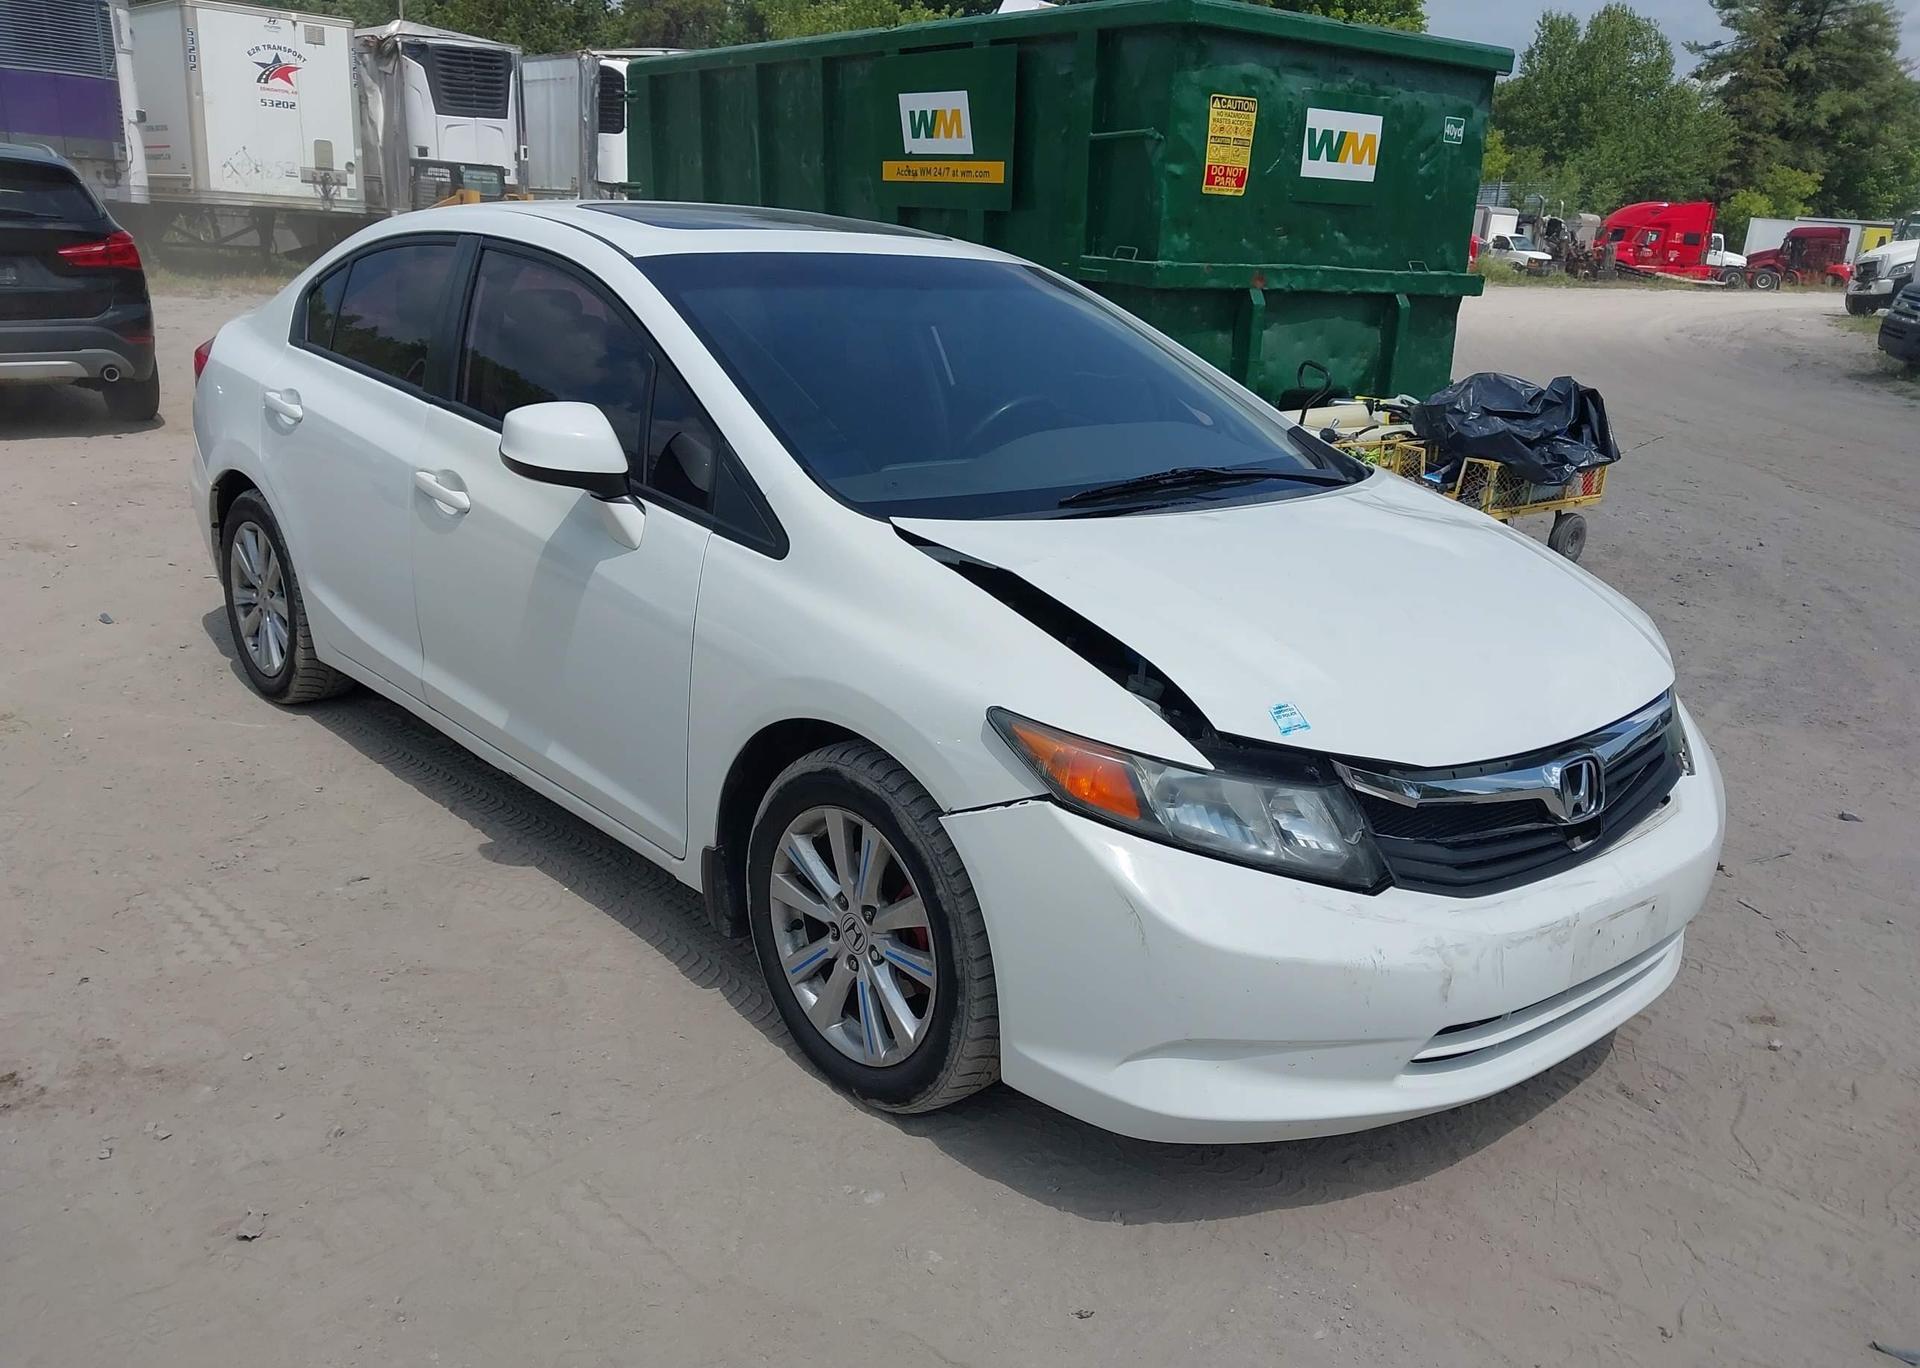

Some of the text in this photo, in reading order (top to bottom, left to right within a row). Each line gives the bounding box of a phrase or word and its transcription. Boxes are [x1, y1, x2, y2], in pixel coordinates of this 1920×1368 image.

[187, 28, 196, 71] 53202
[262, 44, 307, 63] TRANSPORT
[260, 98, 296, 110] 53202
[1221, 98, 1255, 111] CAUTION
[908, 108, 964, 139] WM
[1445, 123, 1464, 139] 40yd
[1308, 127, 1377, 166] WM
[896, 167, 990, 178] Access WM 24/7 at wm.com
[1211, 165, 1244, 177] DO NOT
[1214, 176, 1238, 187] PARK
